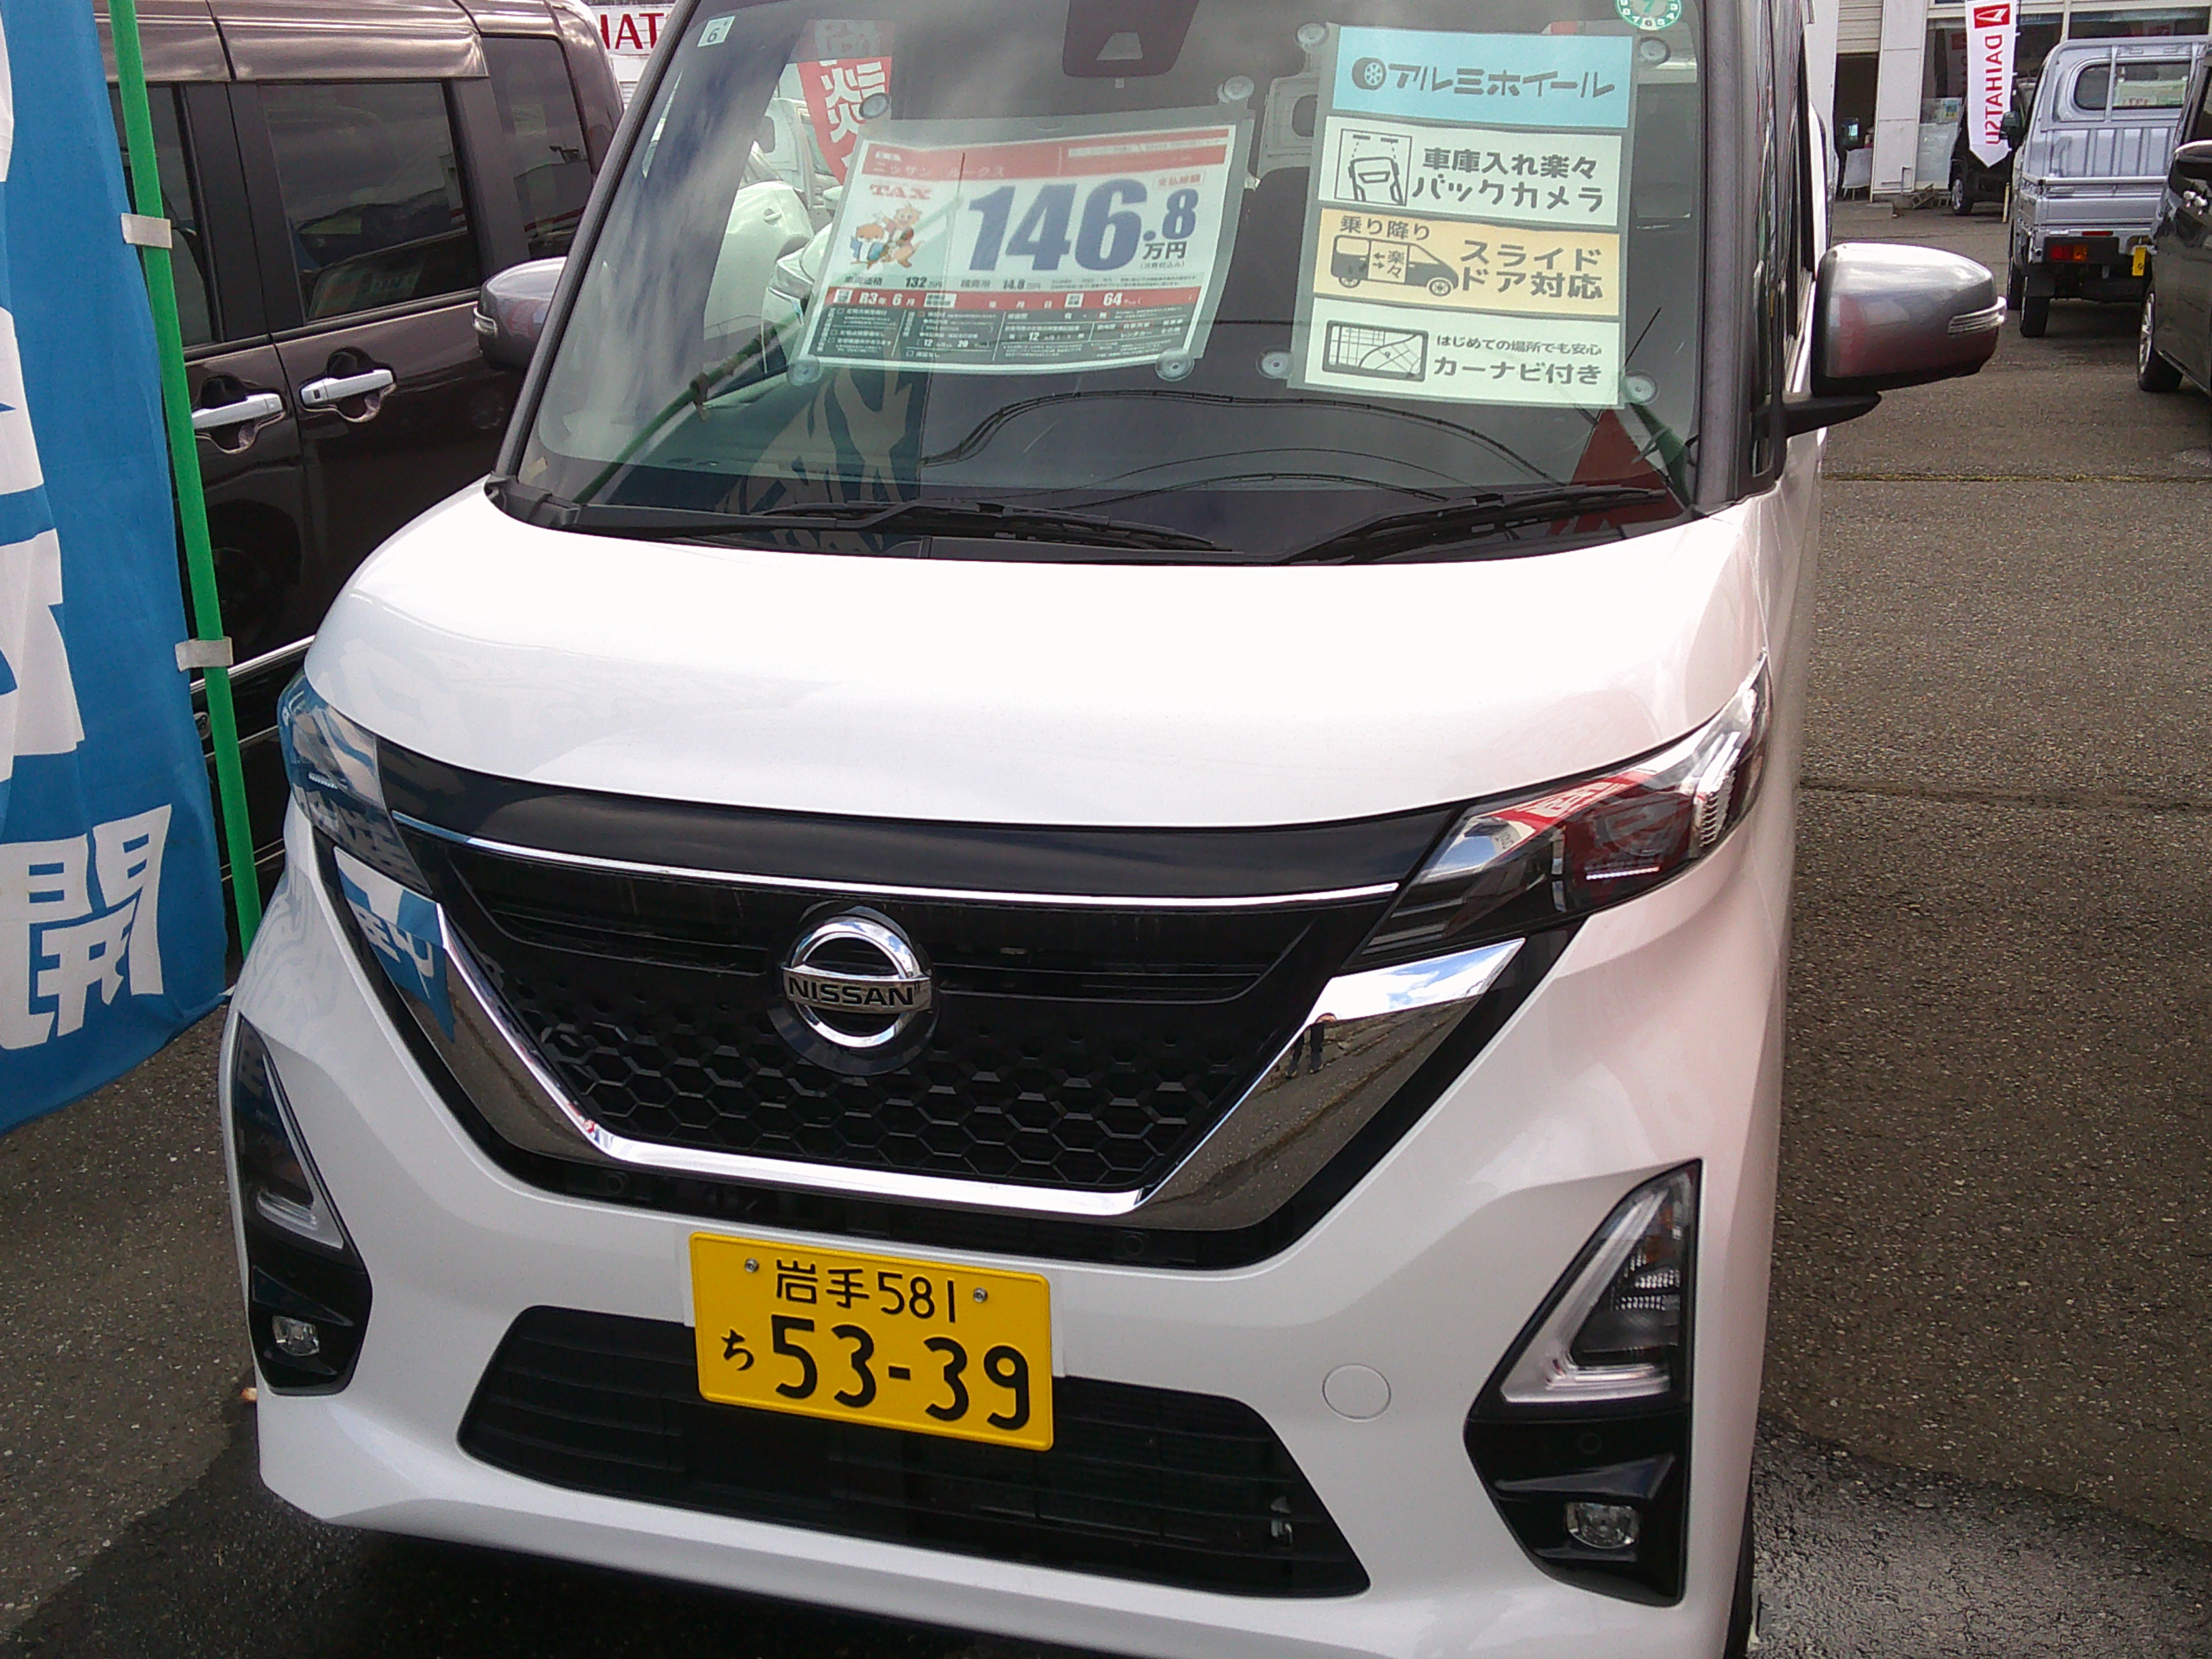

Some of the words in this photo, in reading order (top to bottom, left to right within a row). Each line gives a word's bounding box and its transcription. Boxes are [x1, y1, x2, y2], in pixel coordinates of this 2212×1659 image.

[1388, 64, 1615, 99] アルミホイール
[1422, 147, 1598, 181] 車庫入れ楽々
[869, 184, 931, 199] TAX
[1413, 174, 1604, 213] バックカメラ
[1340, 215, 1430, 240] 乗り降り
[1142, 241, 1187, 260] 万円
[1387, 250, 1403, 279] 楽々
[1460, 239, 1602, 271] スライド
[905, 276, 927, 288] 132
[1461, 266, 1603, 299] ドア対応
[1436, 335, 1602, 356] はじめての場所でも安心
[1433, 356, 1602, 386] カーナビ付き
[788, 977, 914, 1007] NISSAN
[720, 1329, 754, 1371] ち
[770, 1314, 1030, 1431] 53-39
